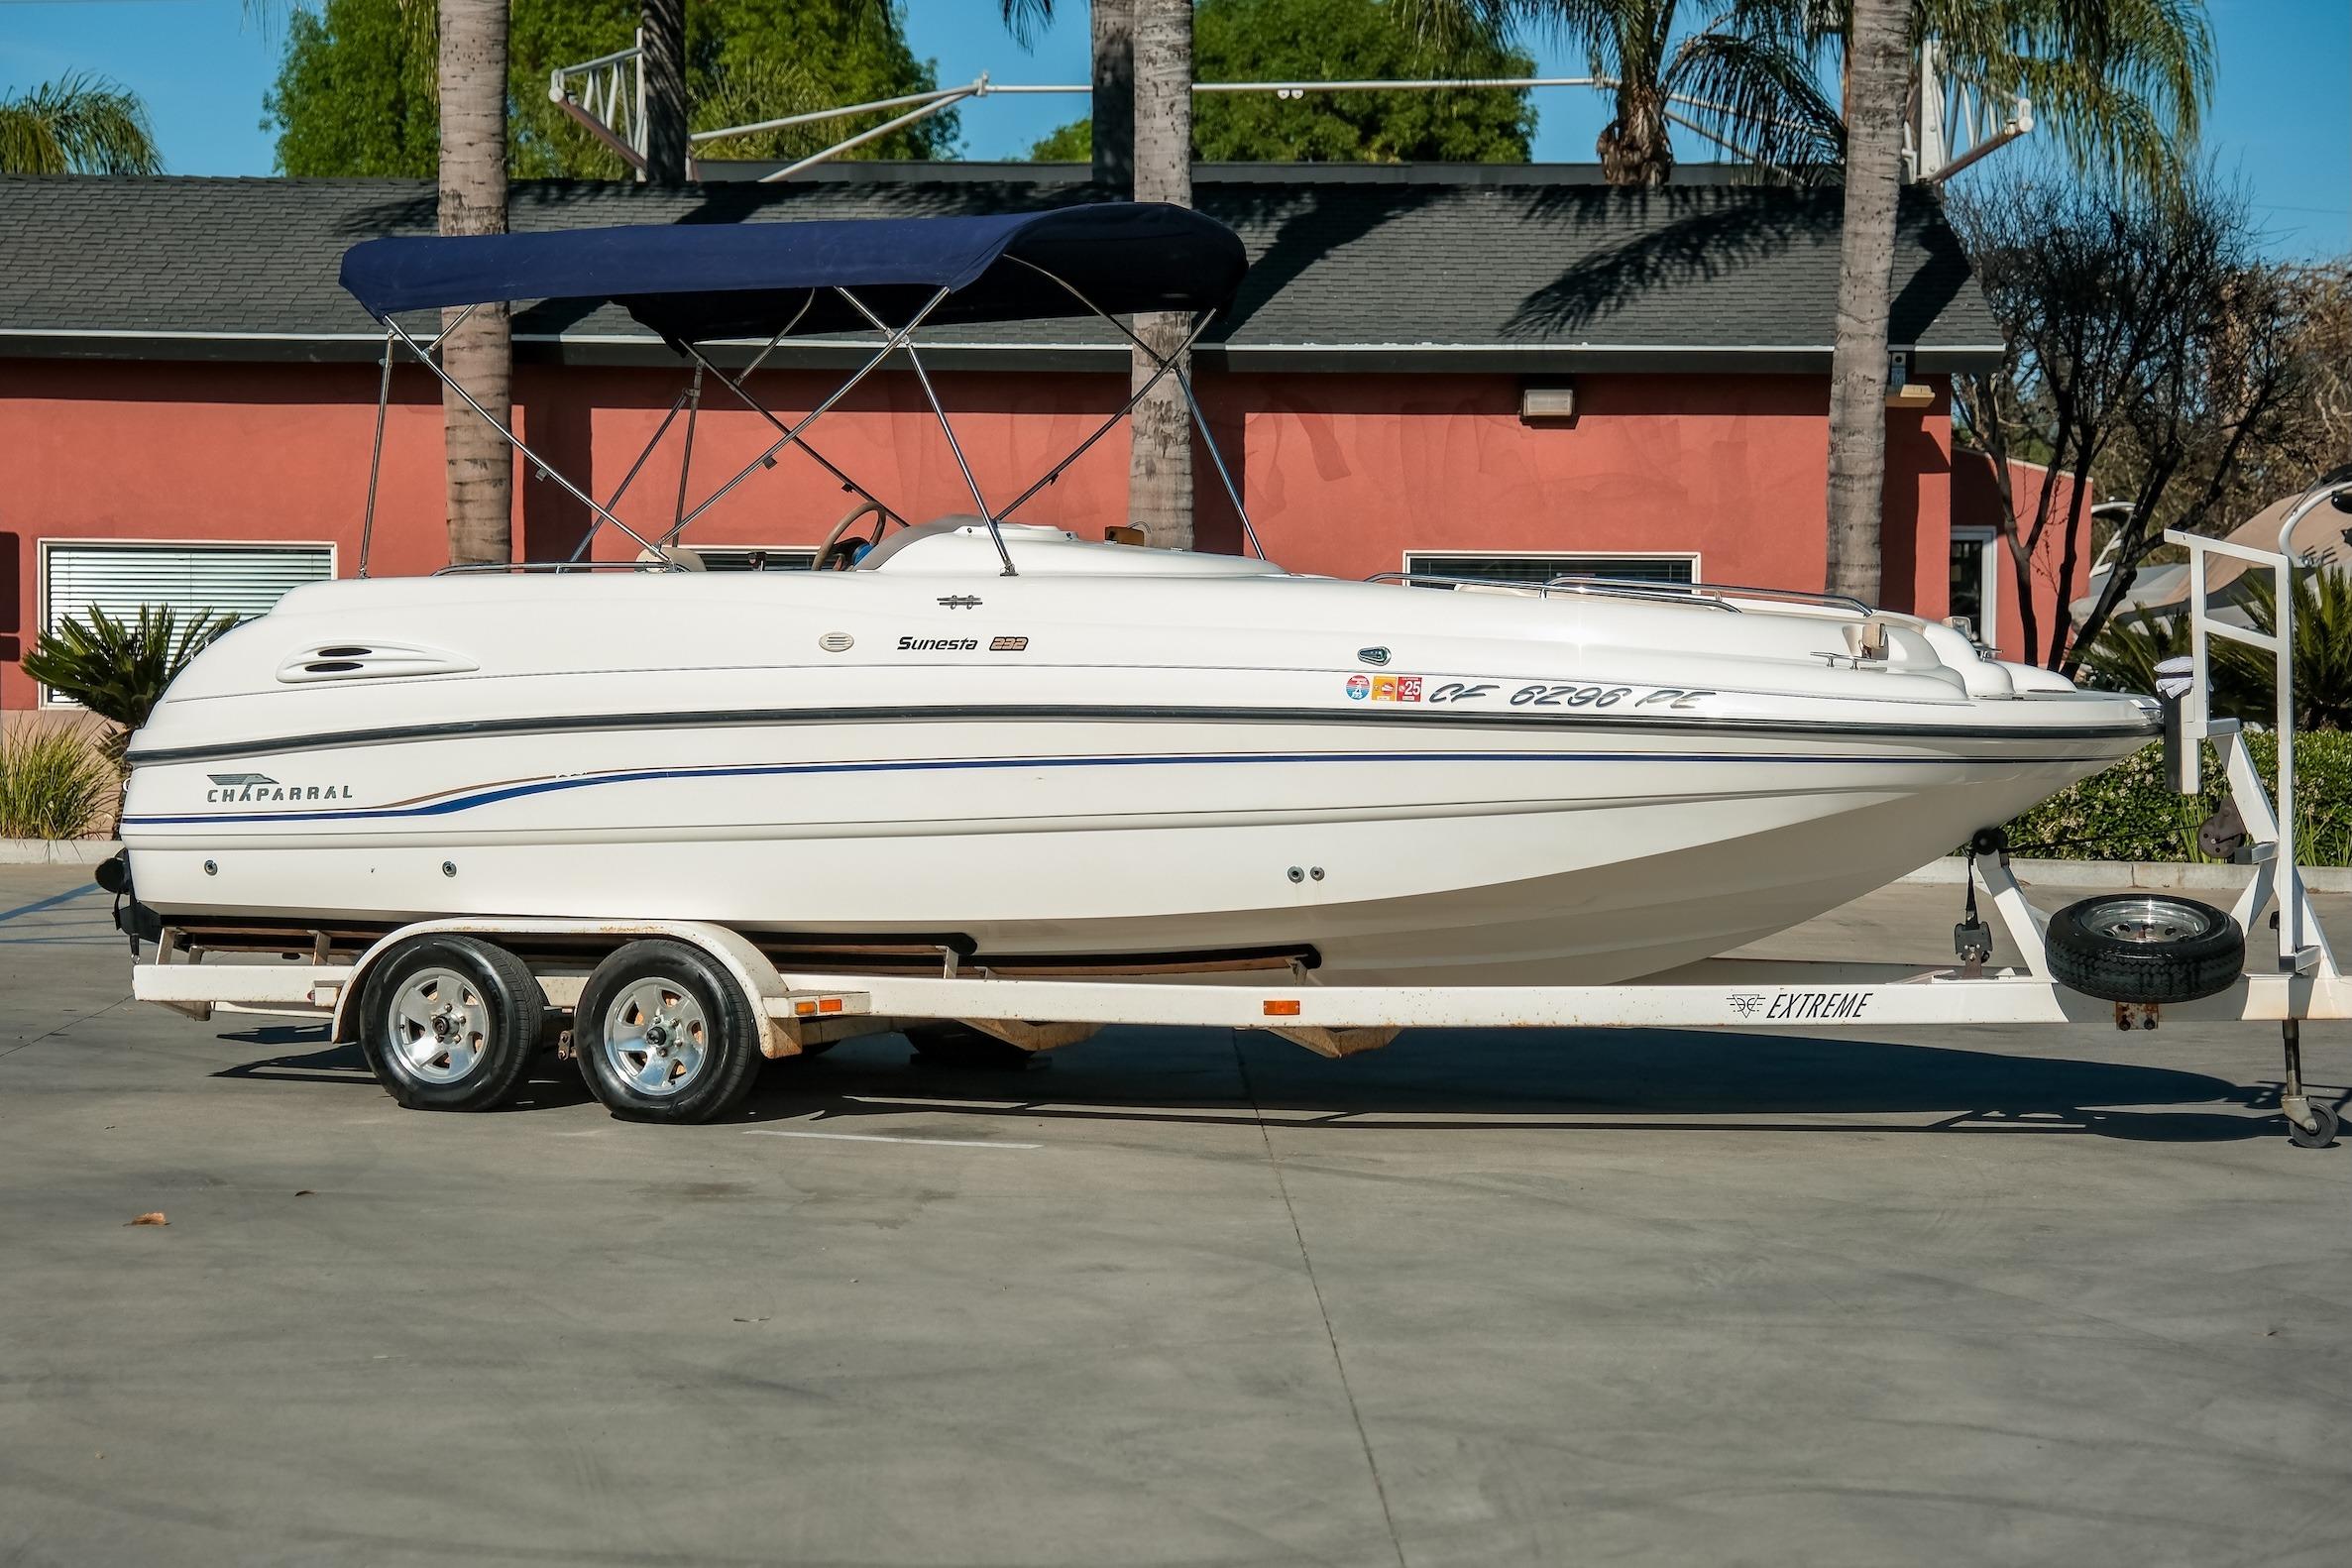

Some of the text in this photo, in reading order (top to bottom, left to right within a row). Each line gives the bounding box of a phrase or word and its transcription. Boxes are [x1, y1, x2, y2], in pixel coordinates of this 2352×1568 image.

[897, 636, 1029, 651] Sunesta 232
[1403, 680, 1421, 696] 25
[1428, 683, 1500, 704] CF
[1634, 689, 1717, 710] PE
[207, 785, 353, 803] CHAPARRAL
[1766, 992, 1874, 1018] EXTREME
